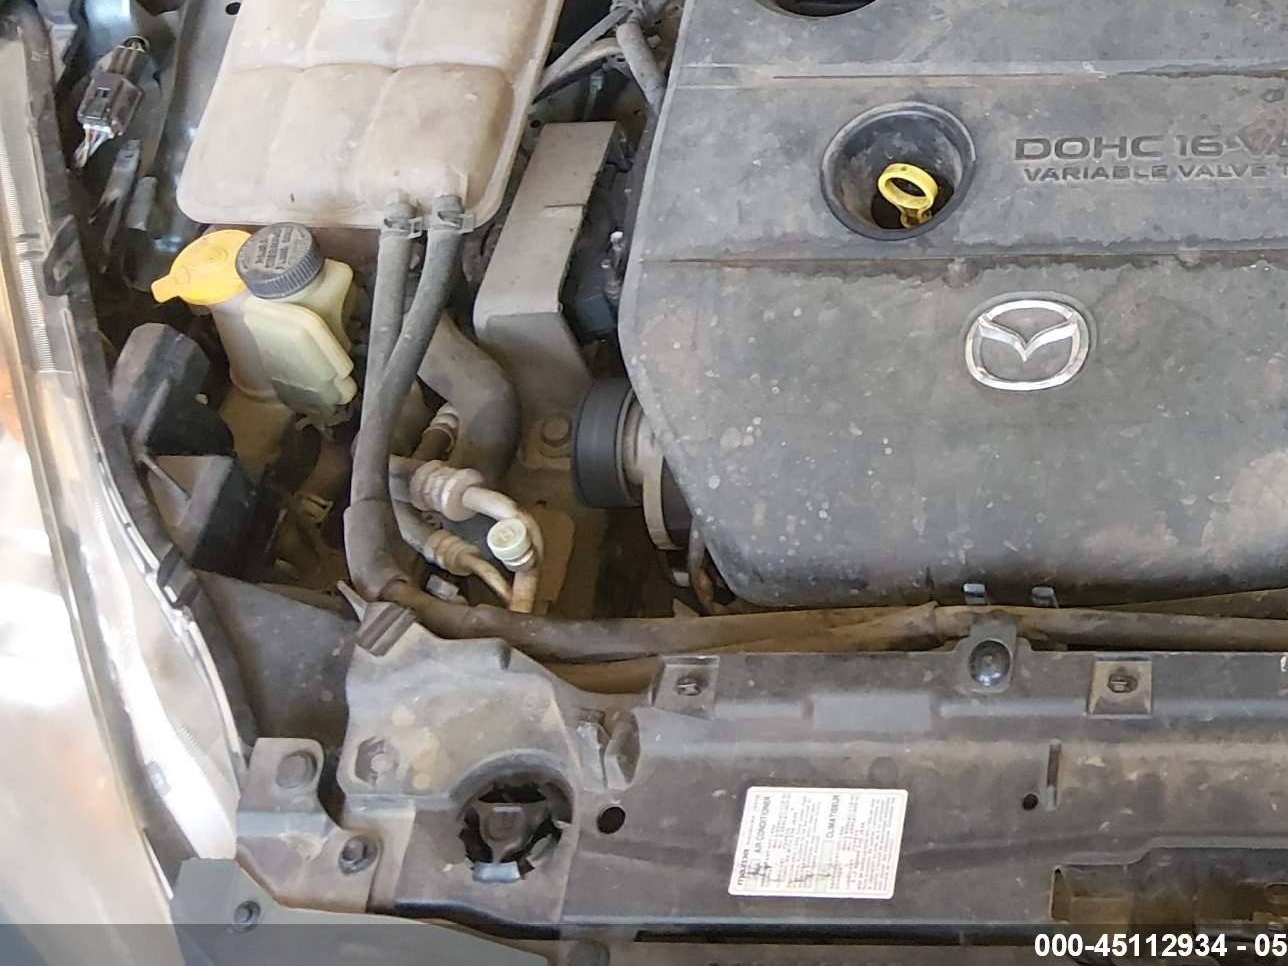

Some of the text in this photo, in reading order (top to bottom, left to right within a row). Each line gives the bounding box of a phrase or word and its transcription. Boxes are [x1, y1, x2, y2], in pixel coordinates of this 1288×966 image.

[1014, 134, 1164, 161] DOHC
[1023, 164, 1169, 182] VARIABLE
[1178, 163, 1267, 179] VALVE
[754, 796, 771, 853] AIR CONDITIONER
[825, 795, 840, 839] CLIMATISEUR
